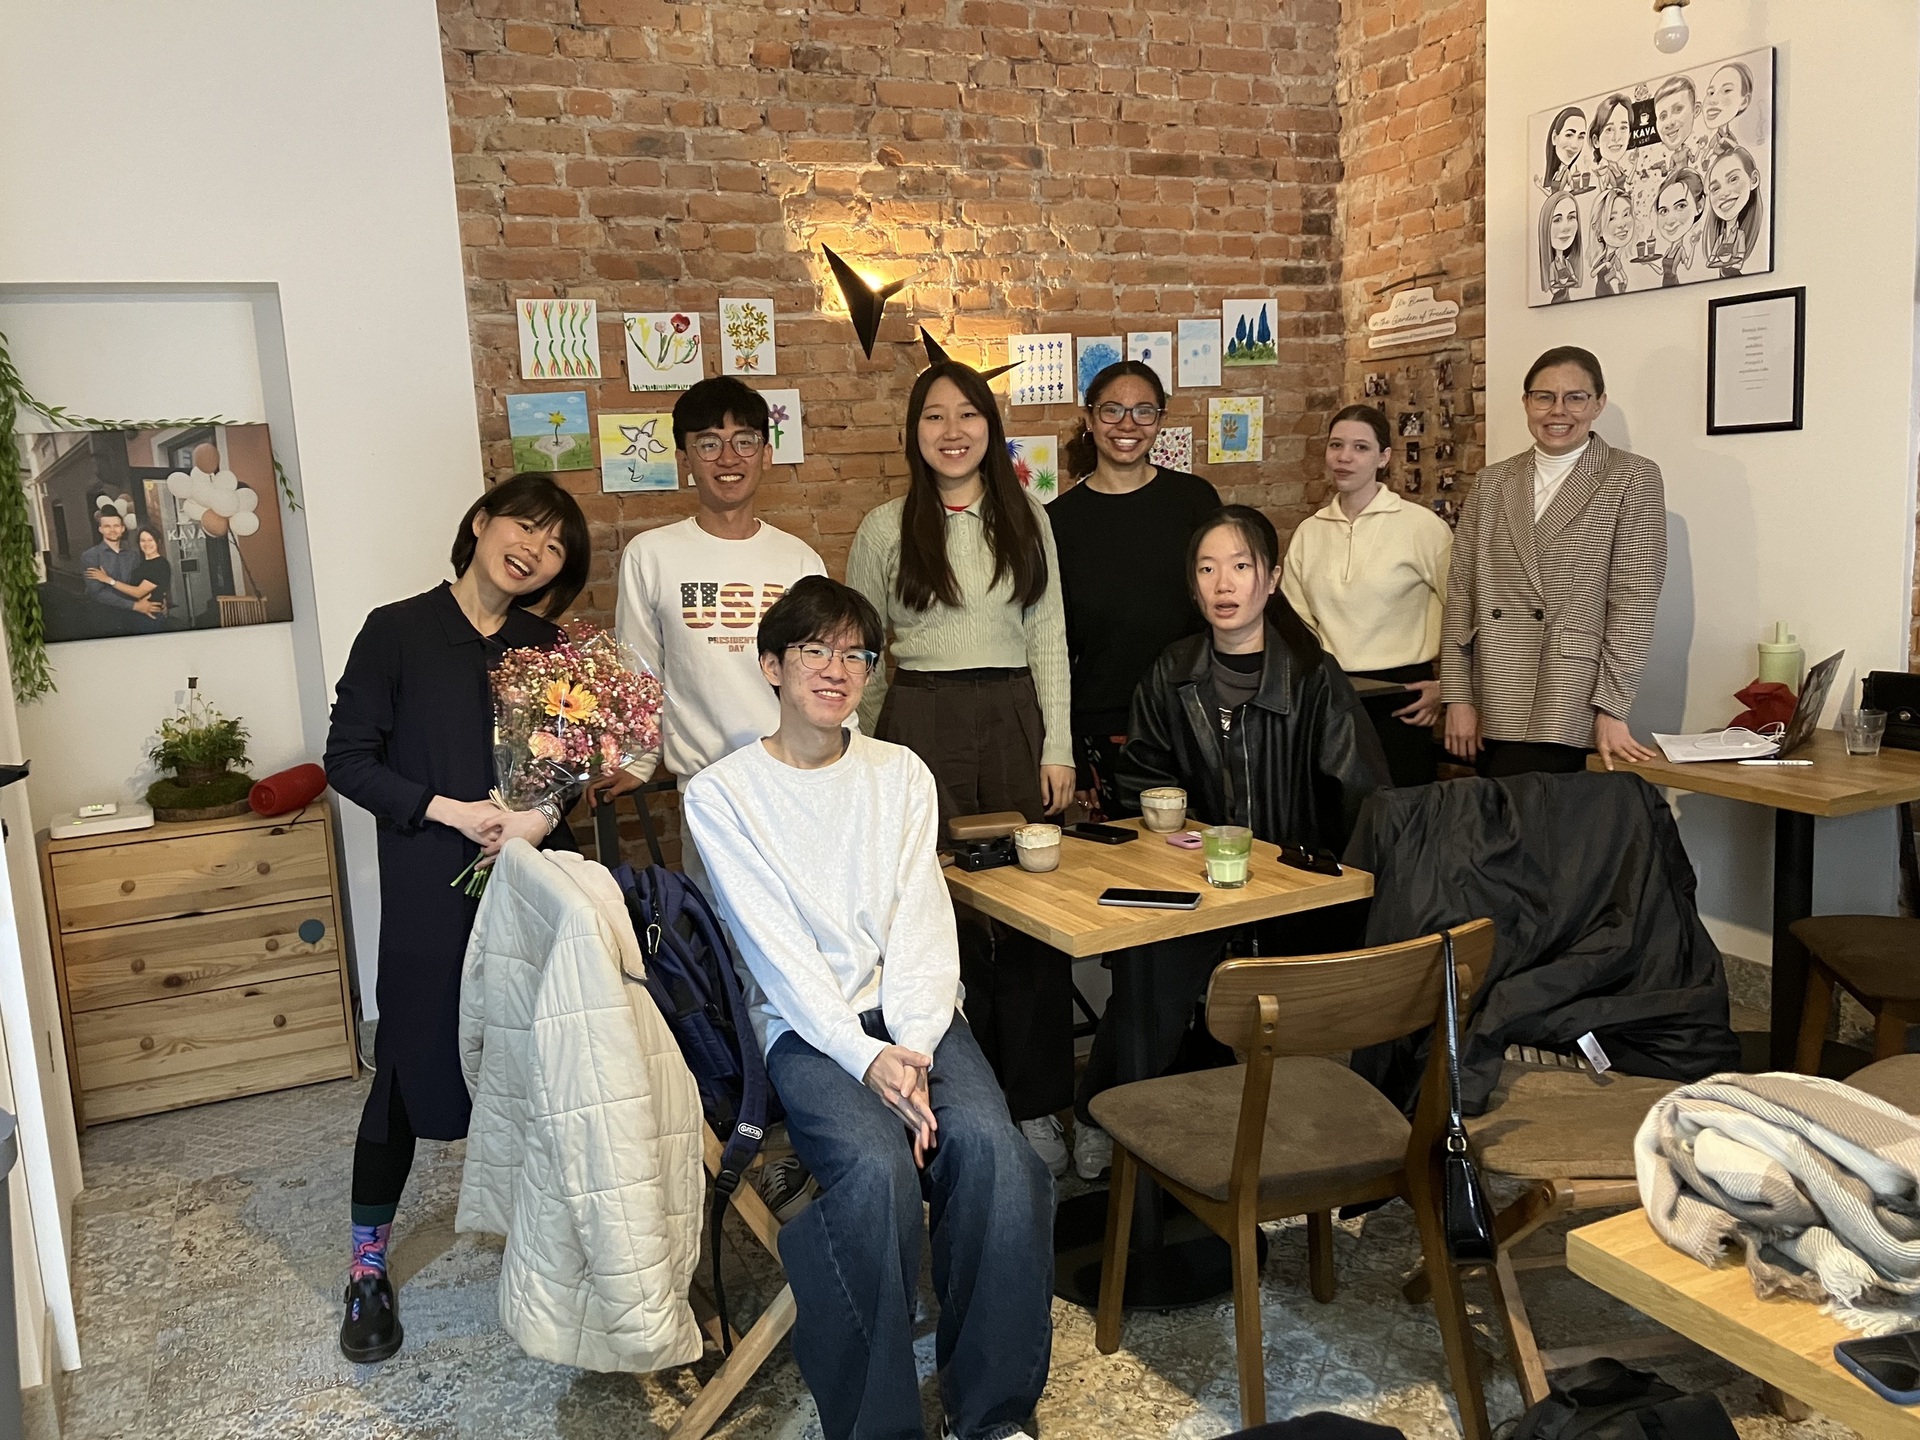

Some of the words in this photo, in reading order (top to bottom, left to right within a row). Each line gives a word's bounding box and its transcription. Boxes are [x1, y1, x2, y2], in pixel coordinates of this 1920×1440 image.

[1633, 126, 1656, 139] KAVA
[1380, 317, 1389, 326] the
[1391, 312, 1418, 326] Garden
[1419, 310, 1427, 323] of
[1428, 307, 1457, 318] Freedom
[167, 524, 207, 541] KAVA
[728, 644, 745, 653] DAY
